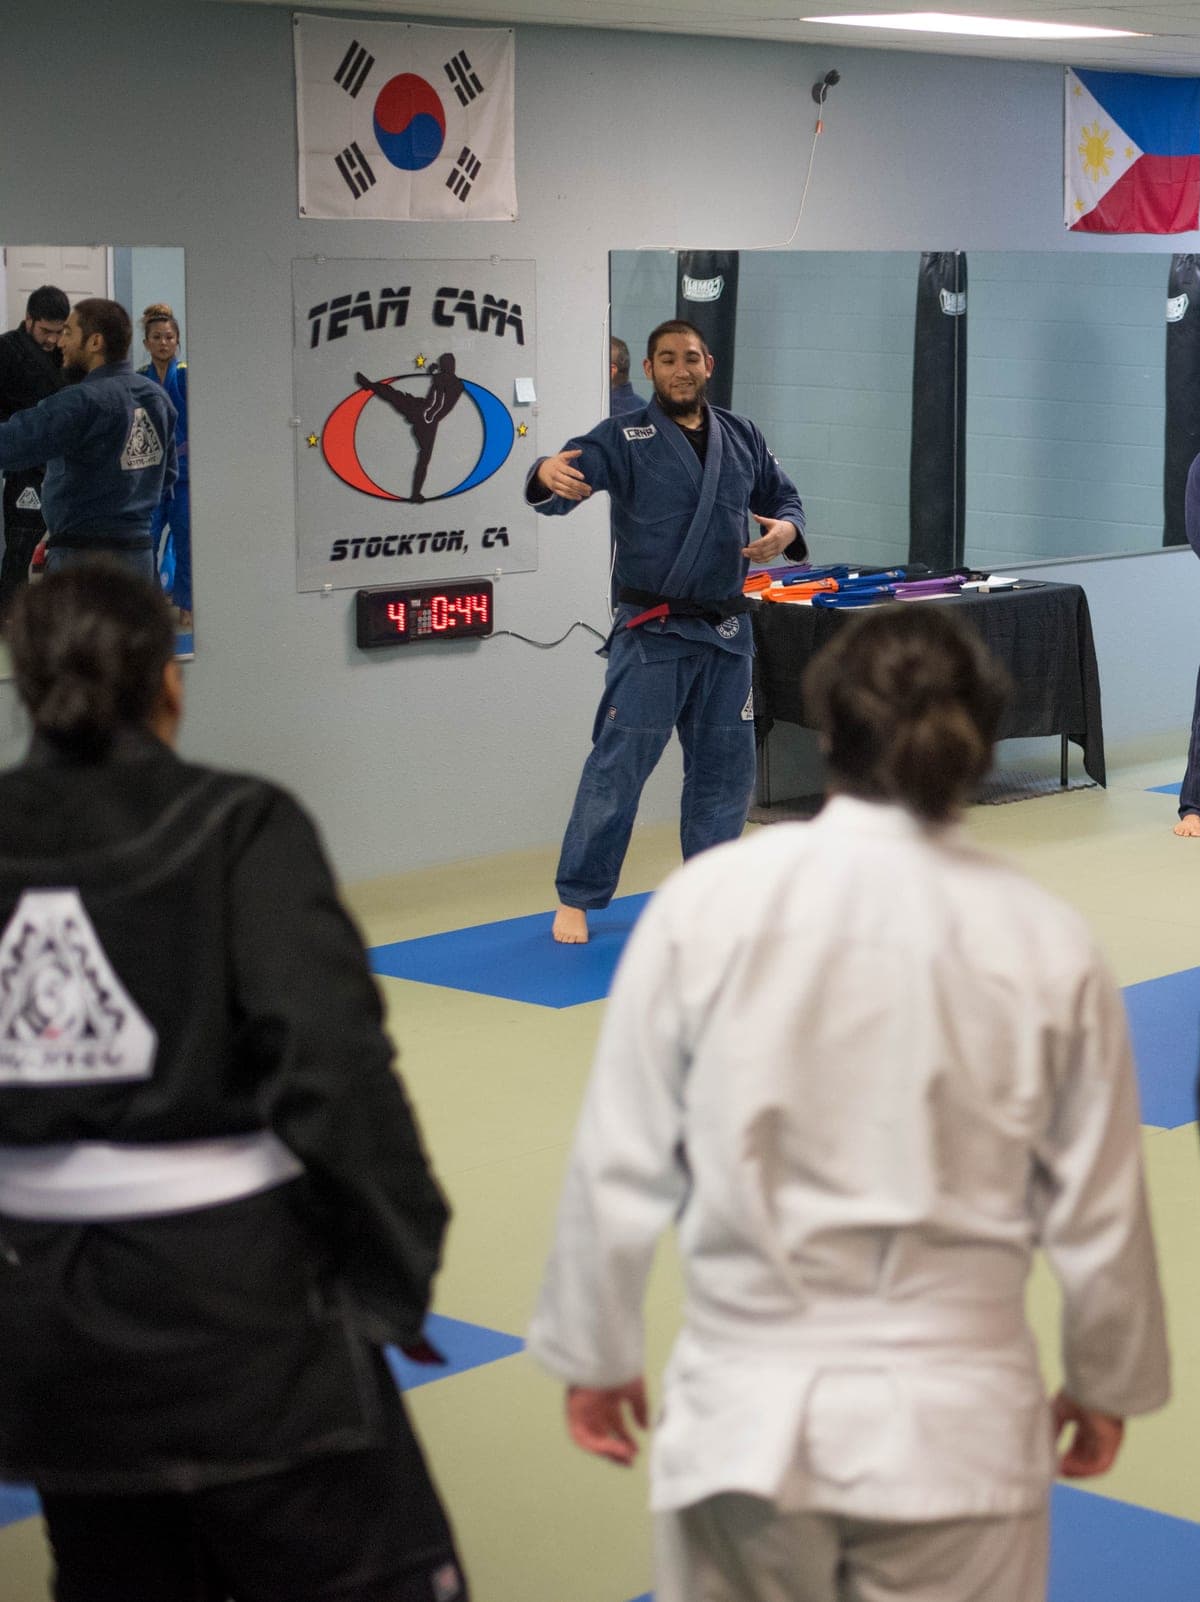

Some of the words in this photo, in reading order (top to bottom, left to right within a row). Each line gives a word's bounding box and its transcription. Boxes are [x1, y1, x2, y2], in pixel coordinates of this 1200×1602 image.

[308, 286, 411, 349] TEAM
[432, 286, 524, 346] CAMA
[330, 530, 468, 561] STOCKTON,
[481, 526, 509, 548] CA
[387, 603, 405, 631] 4
[431, 595, 488, 629] 0:44
